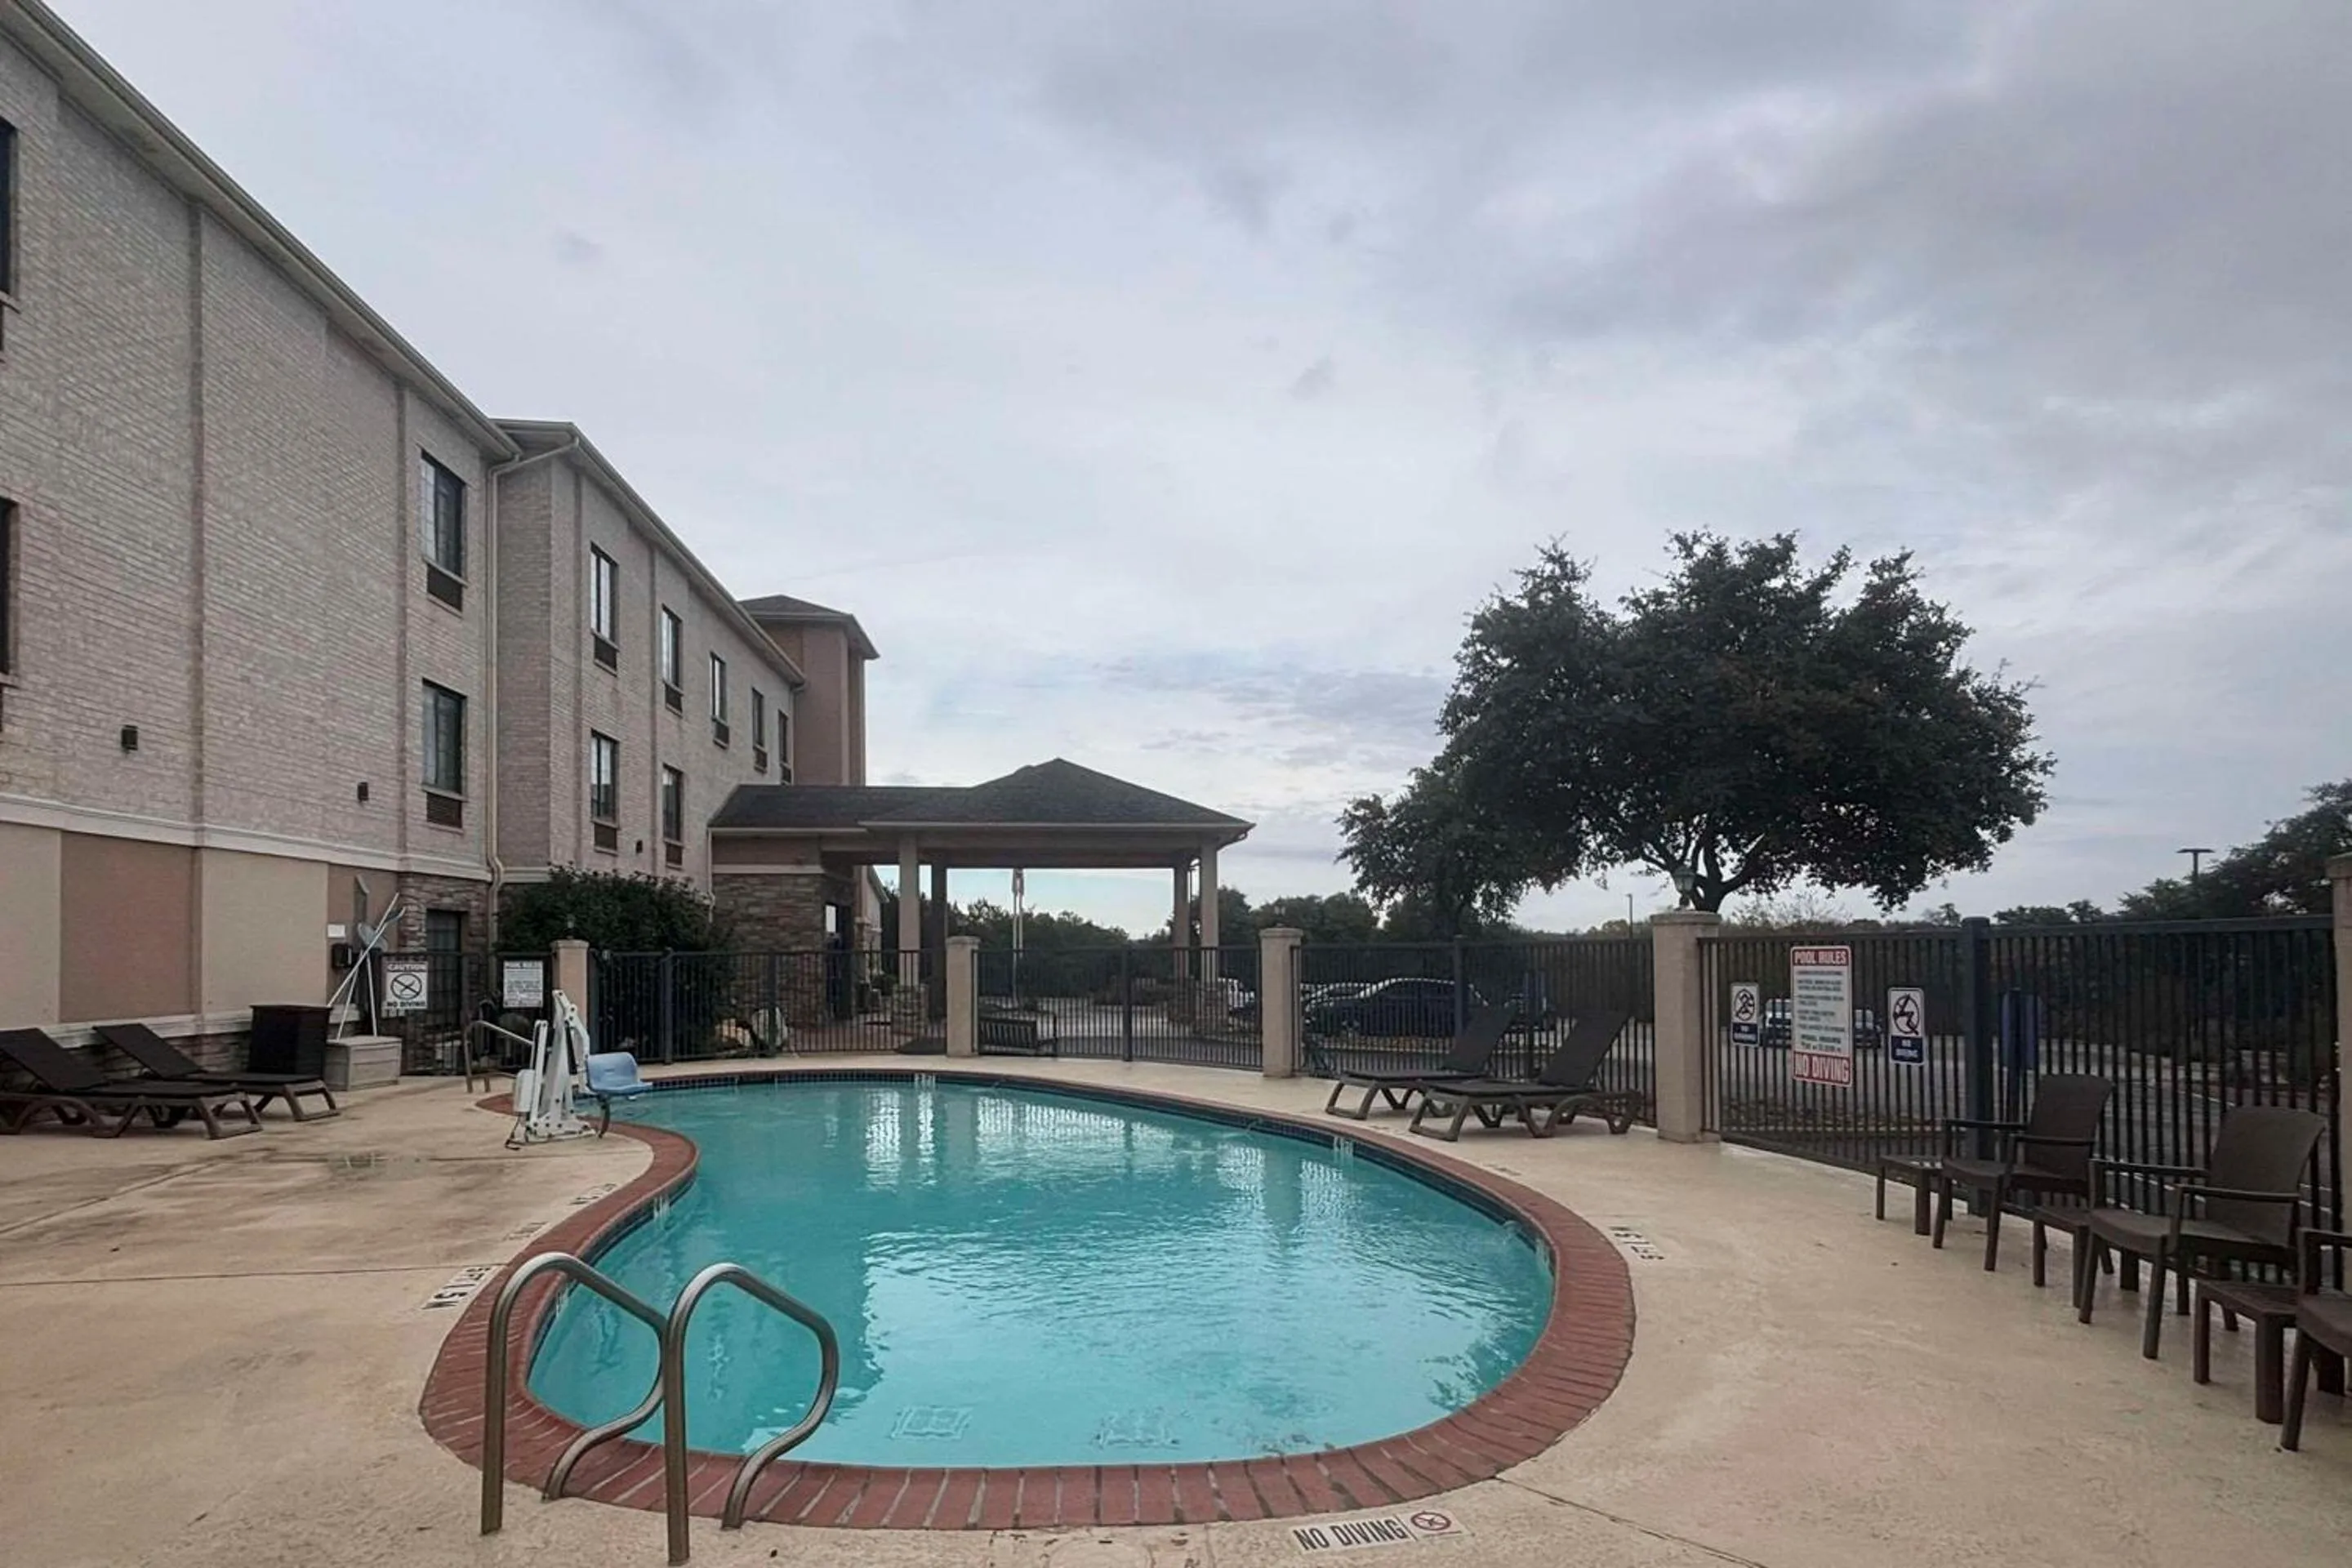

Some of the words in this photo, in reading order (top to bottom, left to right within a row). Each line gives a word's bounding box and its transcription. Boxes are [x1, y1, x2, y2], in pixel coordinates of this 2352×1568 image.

[387, 963, 426, 972] CAUTION
[1795, 1053, 1810, 1077] NO
[1811, 1056, 1850, 1083] DIVING
[1293, 1527, 1330, 1551] NO
[1330, 1518, 1409, 1547] DIVING
